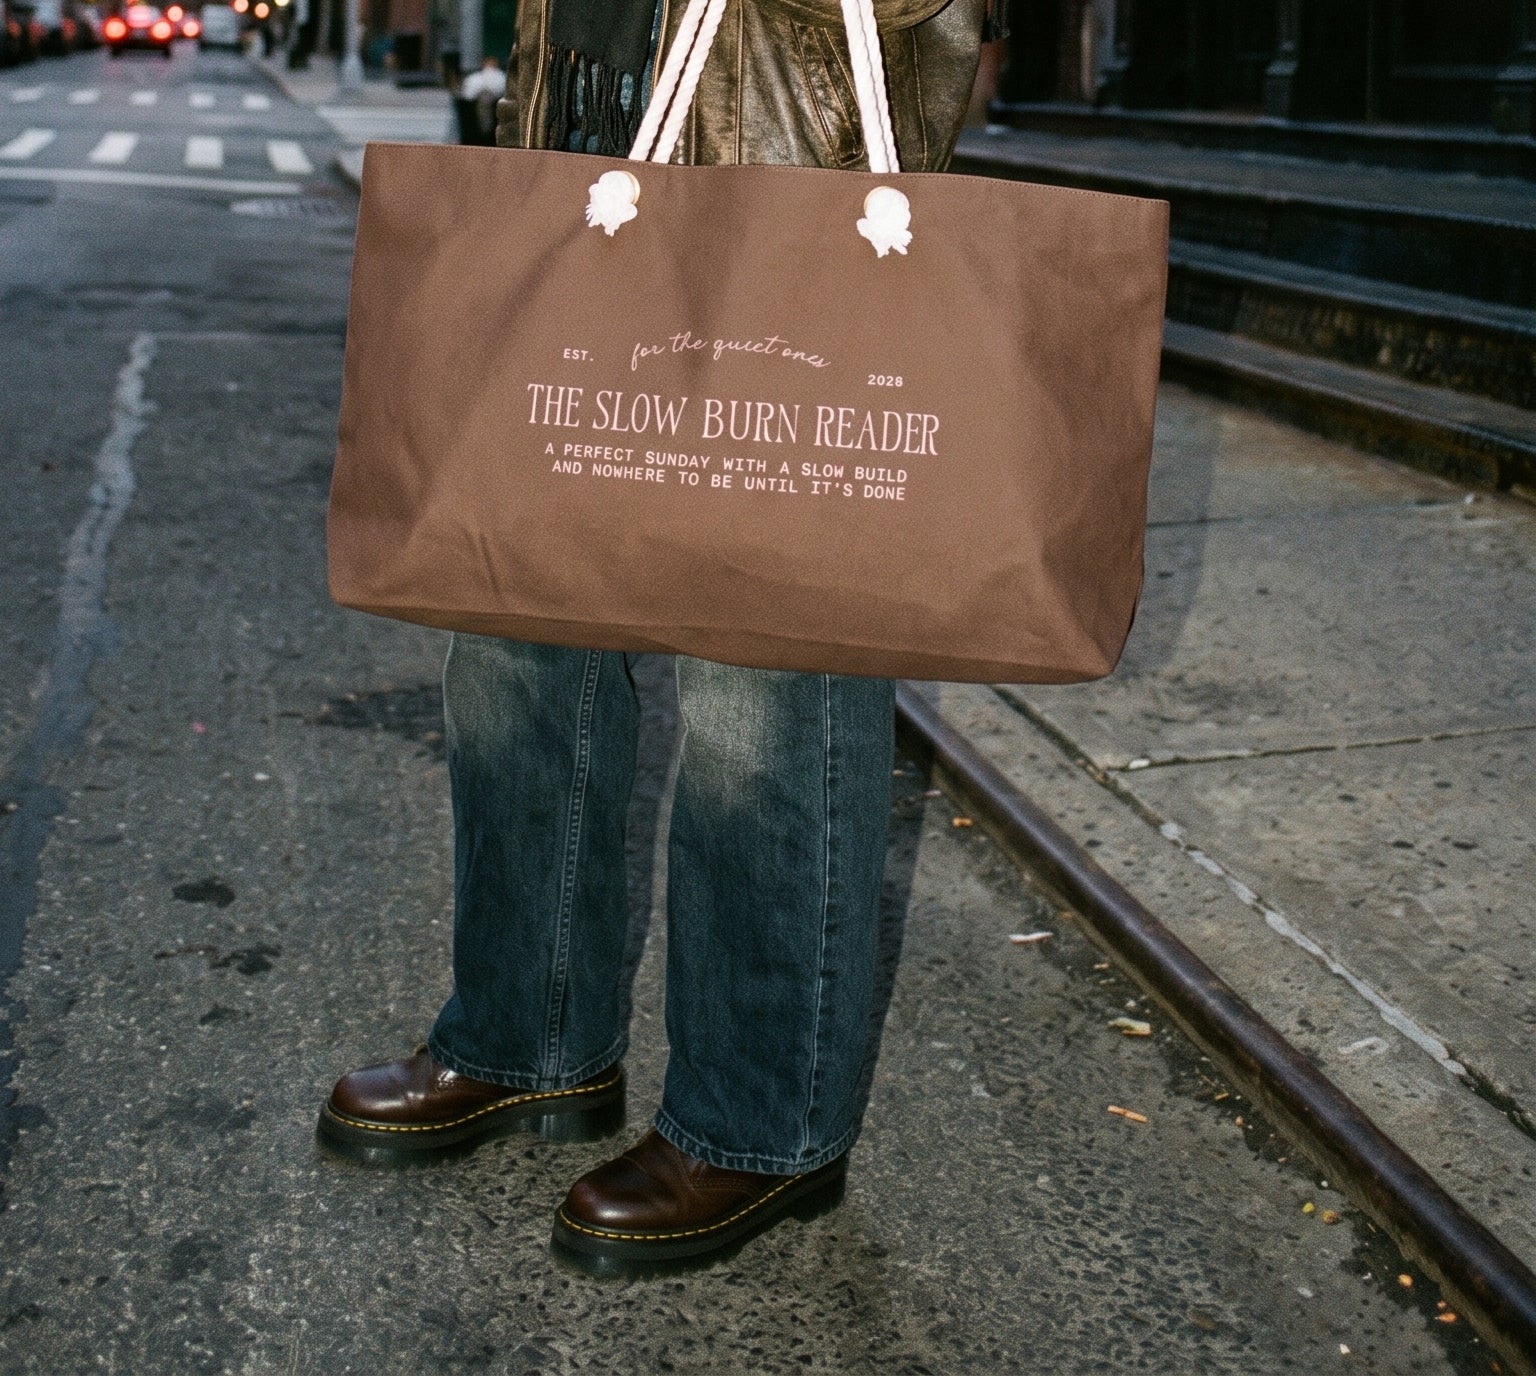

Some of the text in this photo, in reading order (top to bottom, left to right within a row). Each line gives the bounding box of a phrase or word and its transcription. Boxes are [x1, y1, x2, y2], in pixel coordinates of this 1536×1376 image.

[563, 348, 594, 362] EST.
[631, 342, 666, 372] for
[669, 331, 708, 353] the
[527, 383, 940, 456] THE SLOW BURN READER
[545, 442, 908, 483] A PERFECT SUNDAY WITH A SLOW BUILD
[552, 460, 906, 501] AND NOWHERE TO BE UNTIL IT'S DONE
